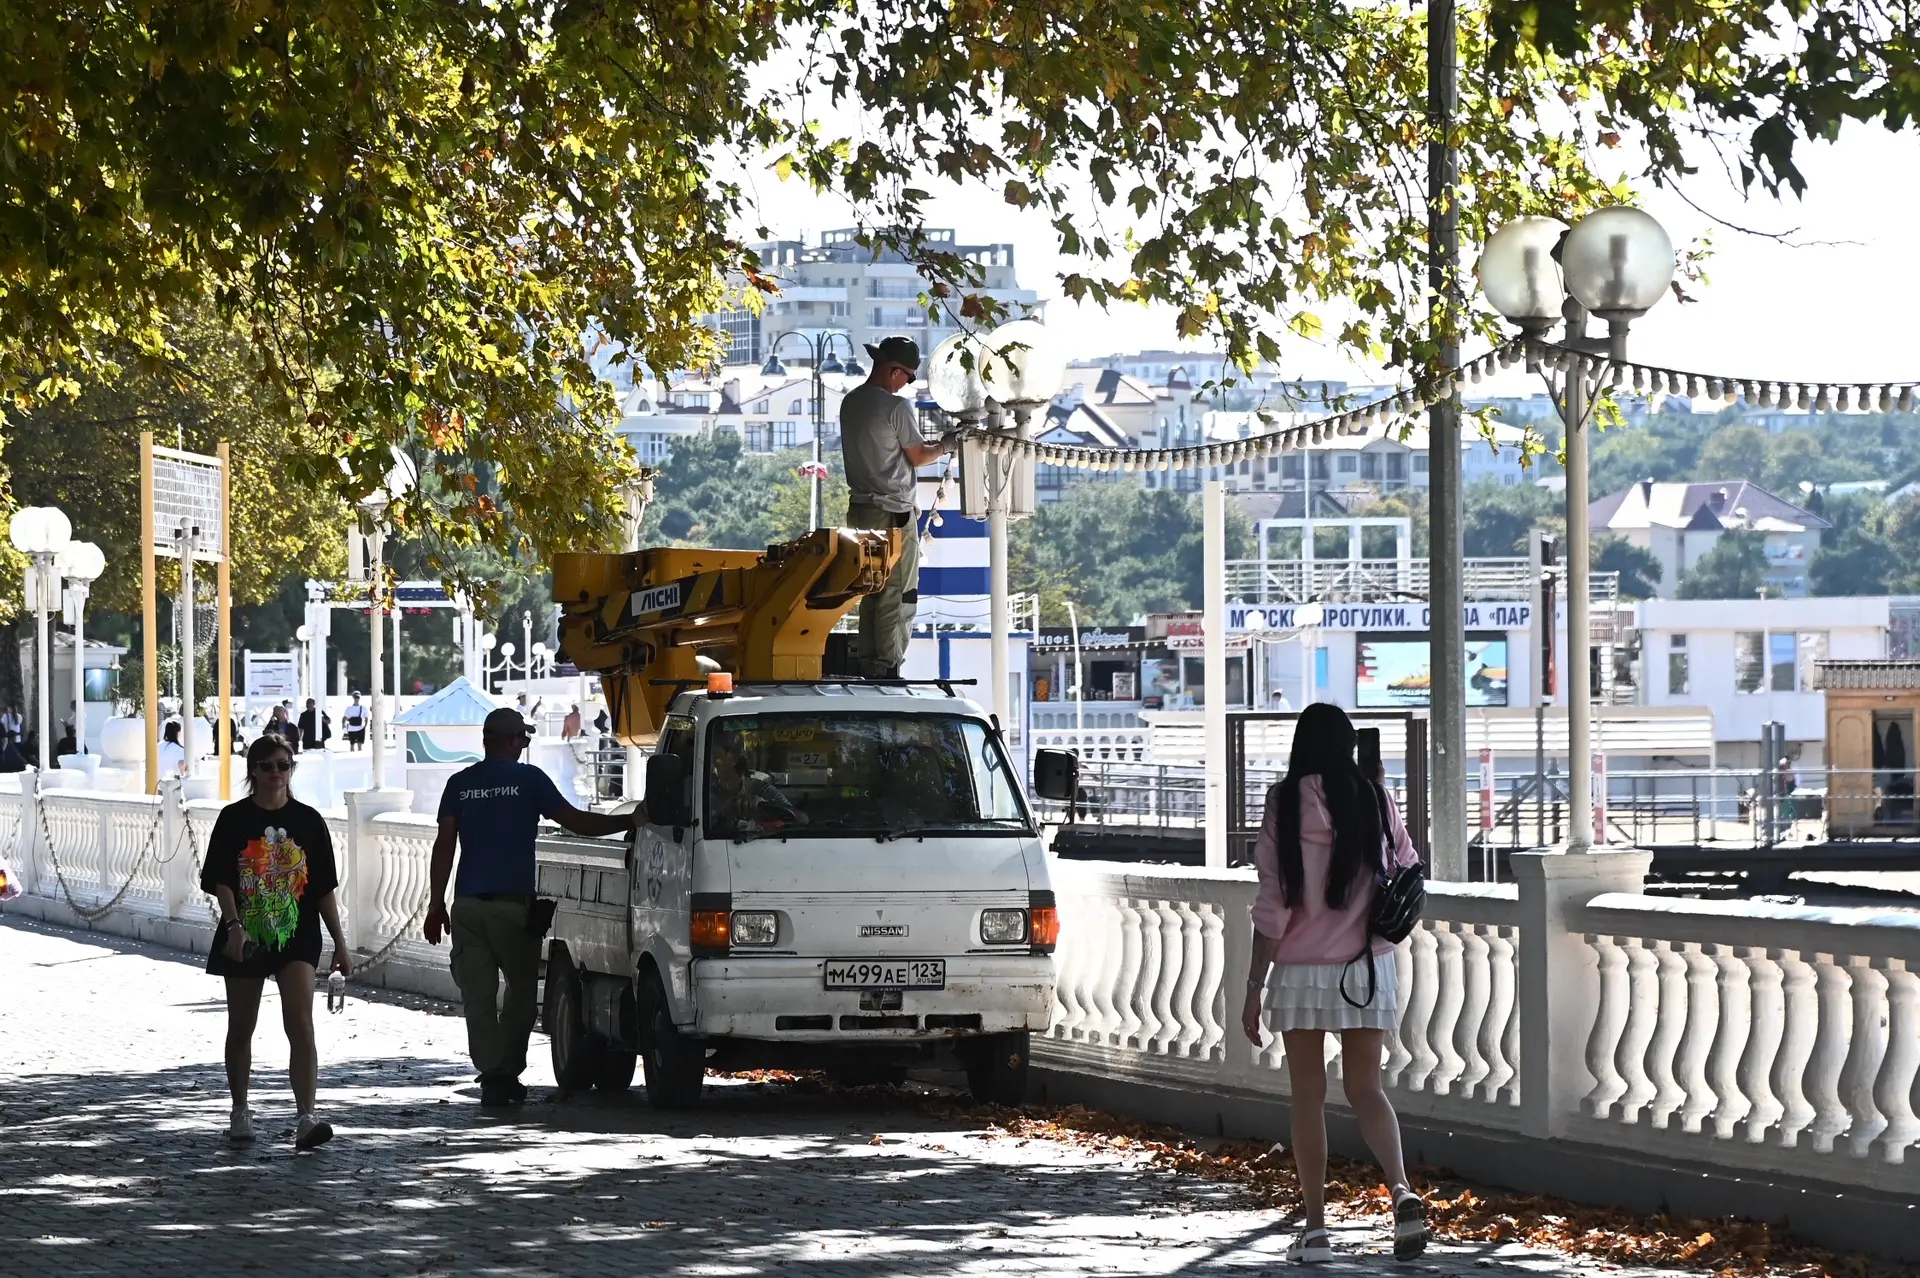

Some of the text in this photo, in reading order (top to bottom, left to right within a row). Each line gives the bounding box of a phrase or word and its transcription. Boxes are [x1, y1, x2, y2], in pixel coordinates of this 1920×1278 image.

[641, 586, 678, 611] AICHI
[1040, 635, 1069, 645] КОФЕ
[460, 785, 519, 801] ЭЛЕКТРИК
[861, 927, 904, 936] NISSAN
[911, 962, 940, 978] 123
[916, 977, 932, 985] RUS
